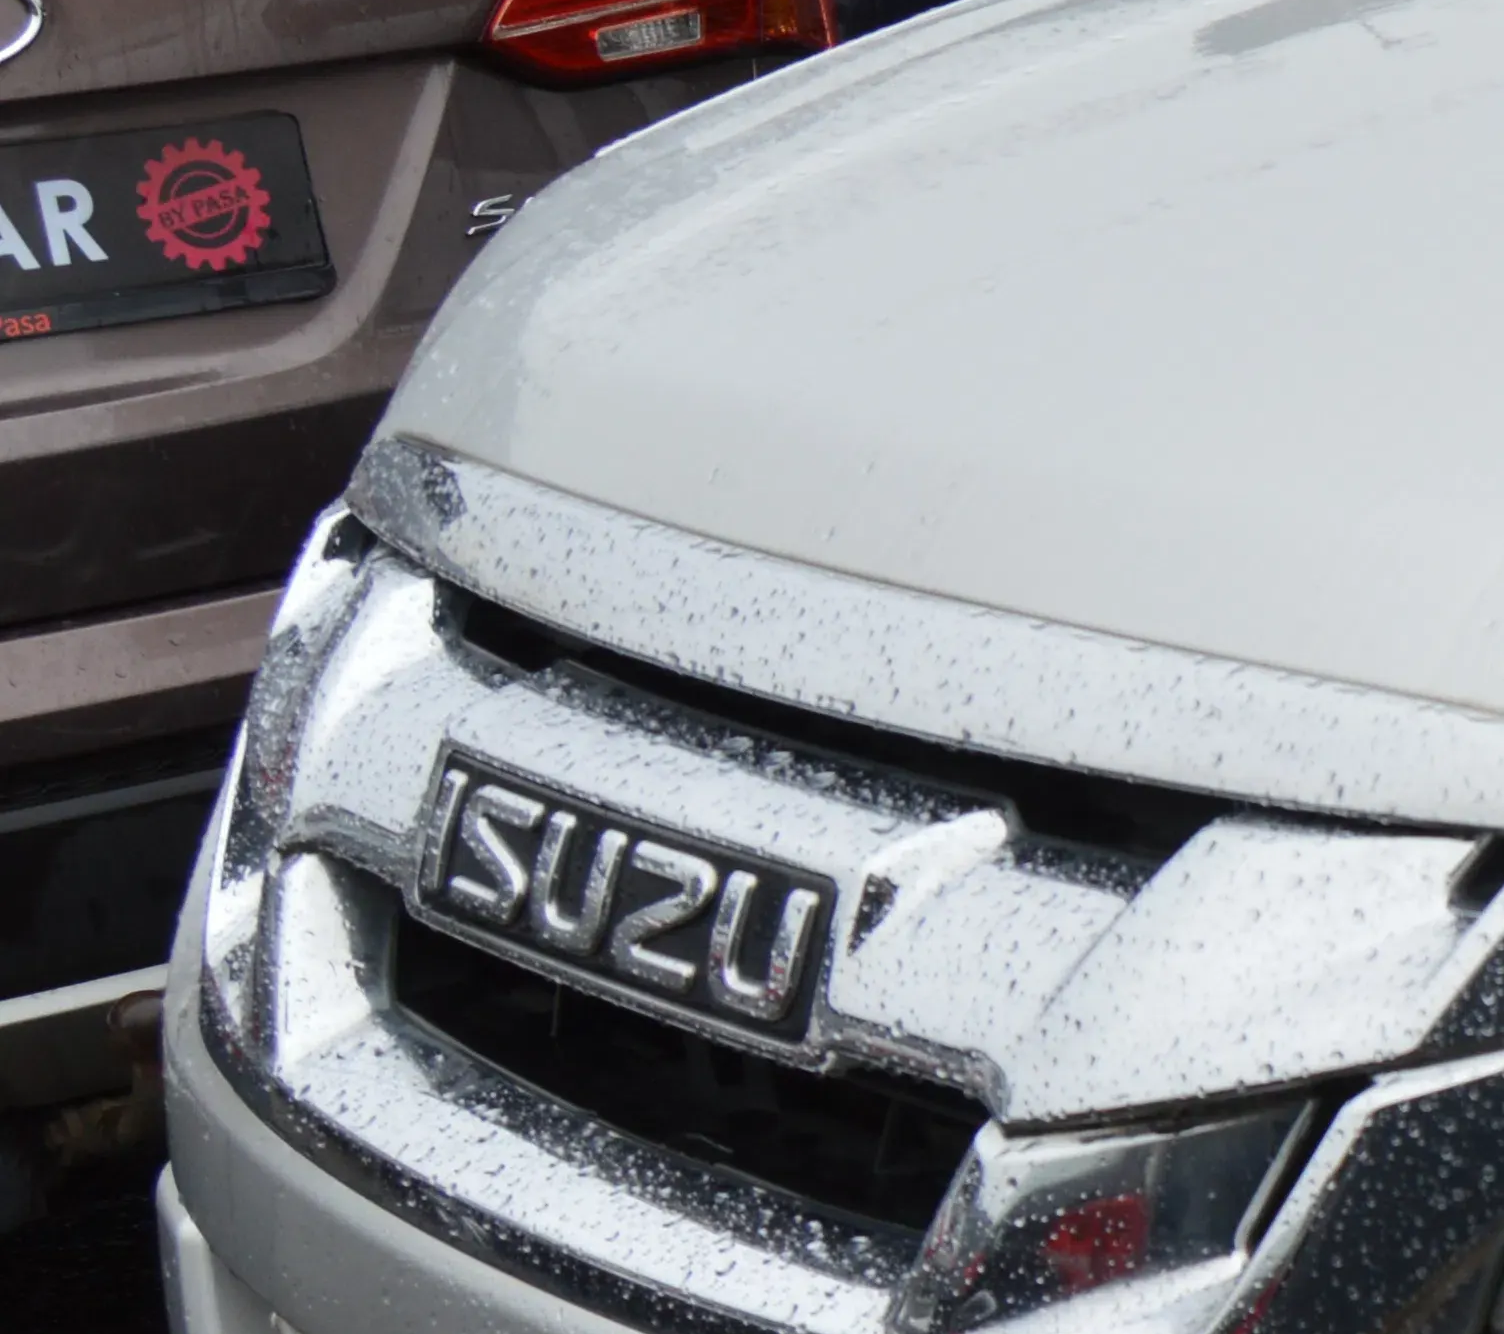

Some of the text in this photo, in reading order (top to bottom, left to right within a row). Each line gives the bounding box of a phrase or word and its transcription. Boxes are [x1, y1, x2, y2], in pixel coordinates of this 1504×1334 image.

[158, 186, 250, 229] BY PASA
[427, 767, 822, 1022] ISUZU
